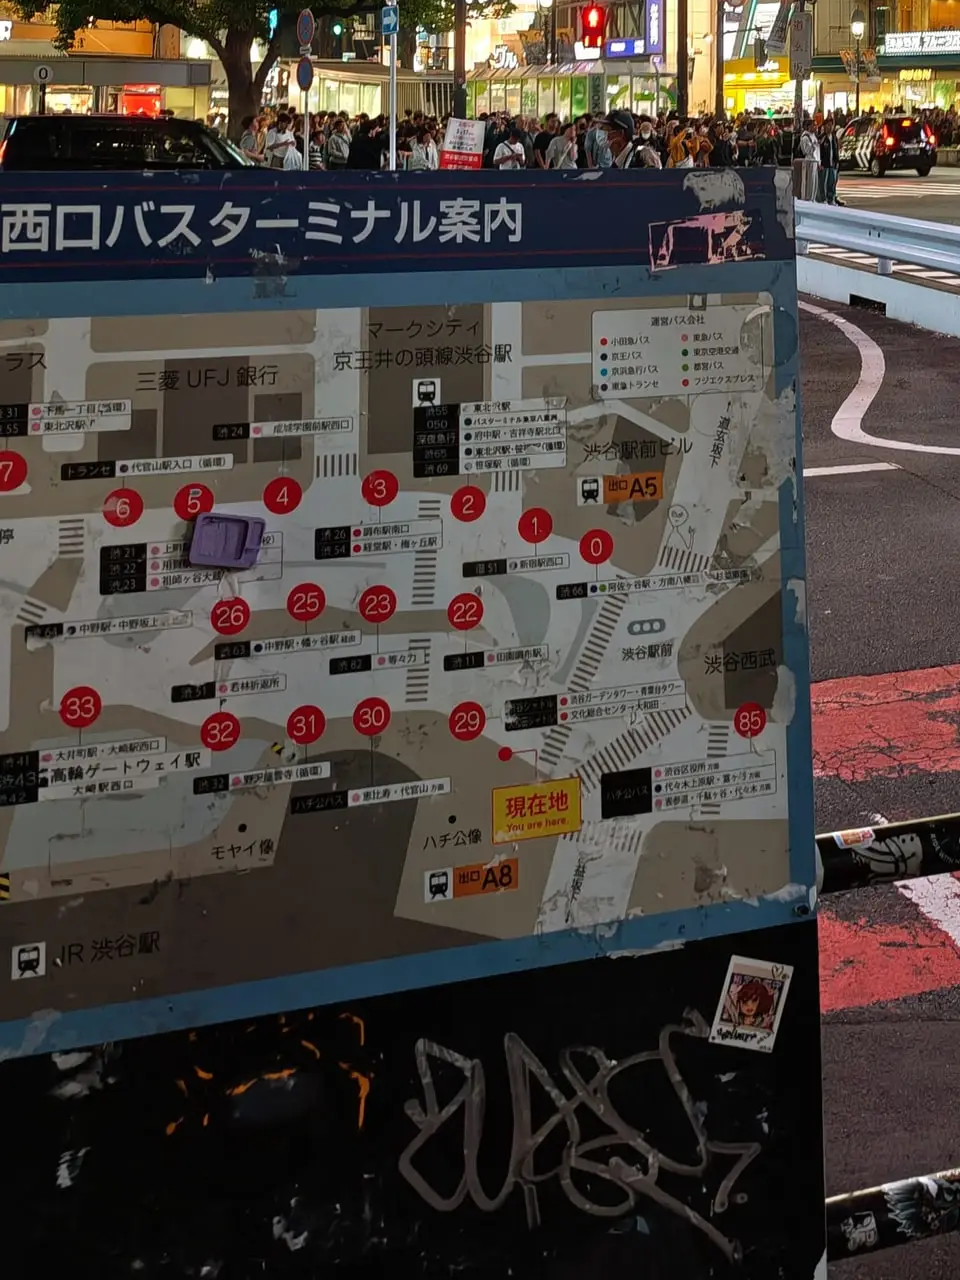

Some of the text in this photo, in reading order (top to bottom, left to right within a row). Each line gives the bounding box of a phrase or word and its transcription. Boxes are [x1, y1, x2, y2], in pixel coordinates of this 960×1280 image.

[0, 196, 523, 254] 西口バスターミナル案内
[368, 320, 479, 340] マークシティ
[651, 314, 705, 327] 運営バス会社
[611, 335, 650, 347] 小田急バス
[333, 343, 513, 371] 京王井の頭線渋谷駅
[611, 350, 643, 361] 京王バス
[611, 364, 659, 376] 京浜急行バス
[693, 361, 724, 371] 都営バス
[136, 365, 279, 392] 三菱 UFJ 銀行
[611, 380, 659, 391] 東急トランセ
[693, 374, 755, 386] フジエクスプレス
[582, 435, 693, 463] 渋谷駅前ビル
[709, 414, 731, 469] 道玄坂下
[66, 464, 111, 477] トランセ
[373, 479, 388, 499] 3
[607, 475, 658, 498] 出口 A5
[187, 488, 202, 513] 5
[276, 489, 290, 506] 4
[461, 495, 475, 515] 2
[115, 498, 131, 518] 6
[363, 523, 410, 537] 調布駅南口
[531, 515, 539, 537] 1
[363, 537, 438, 553] 経堂駅・梅ヶ丘駅
[589, 537, 603, 557] 0
[518, 556, 564, 569] 新宿駅西口
[293, 592, 320, 613] 25
[365, 594, 390, 614] 23
[453, 602, 478, 622] 22
[216, 605, 244, 627] 26
[387, 649, 417, 665] 等々力
[621, 642, 674, 662] 渋谷駅前
[703, 648, 777, 675] 渋谷西武
[66, 696, 96, 719] 33
[359, 706, 385, 728] 30
[293, 715, 316, 736] 31
[454, 713, 481, 733] 29
[738, 711, 762, 731] 85
[206, 720, 234, 744] 32
[55, 739, 160, 762] 大井町駅・大崎駅西口
[49, 751, 201, 785] 高輪ゲートウェイ駅
[71, 780, 134, 796] 大崎駅西口
[504, 789, 569, 819] 現在地
[506, 823, 525, 834] You
[526, 820, 544, 830] are
[422, 827, 483, 852] ハチ公像
[458, 863, 513, 891] 出口 A8
[90, 931, 161, 962] 渋谷駅
